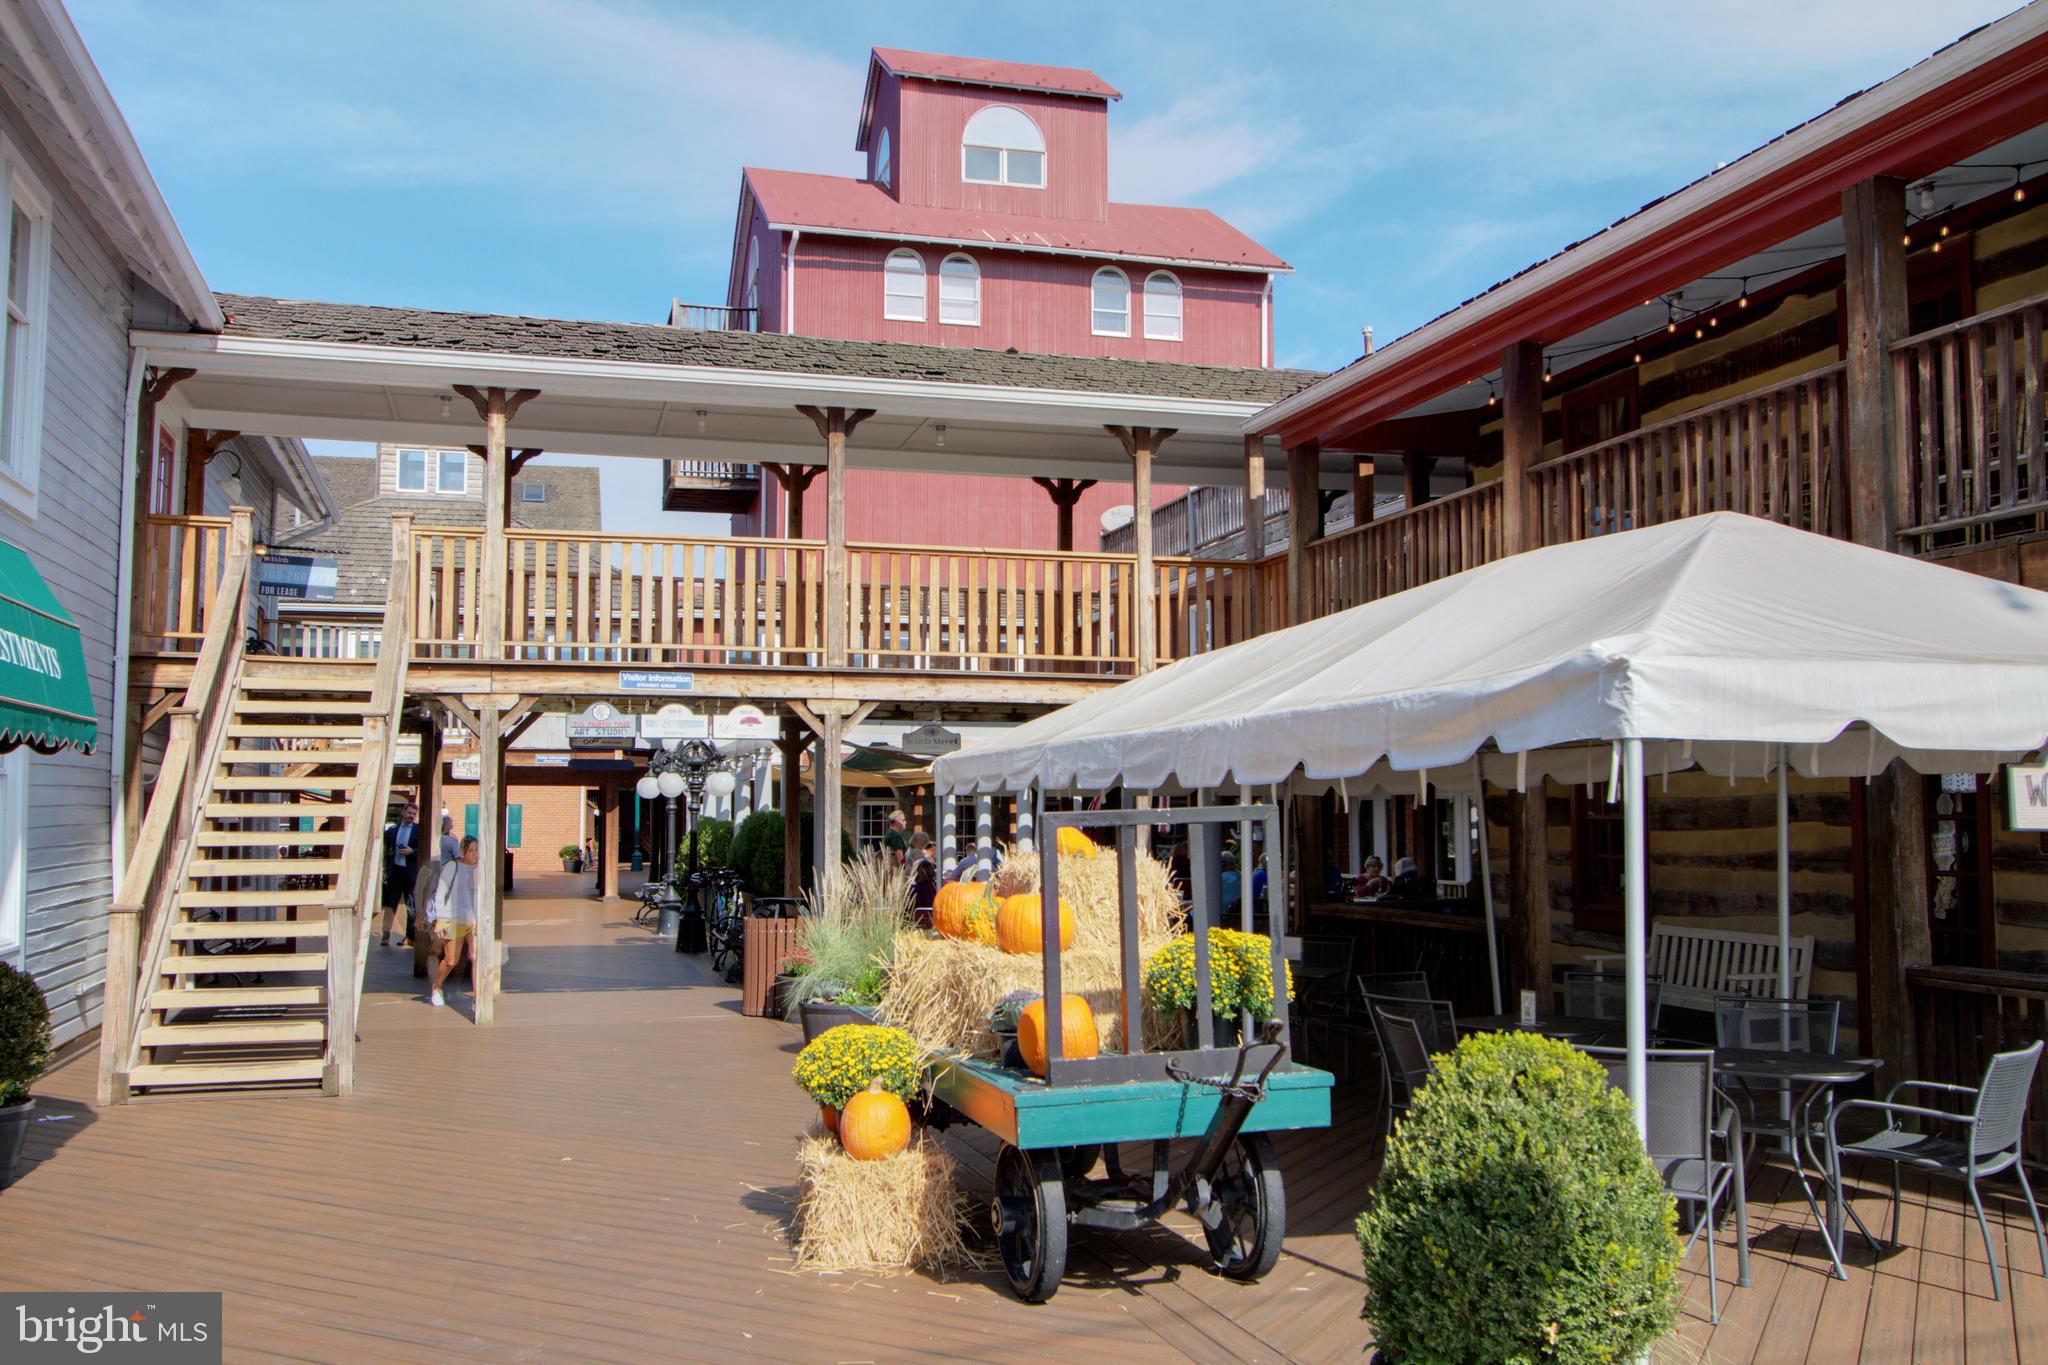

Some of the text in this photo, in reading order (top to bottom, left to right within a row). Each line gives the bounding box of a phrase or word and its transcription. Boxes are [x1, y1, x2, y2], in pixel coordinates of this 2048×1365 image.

[261, 586, 298, 596] FOR LEASE
[622, 673, 692, 683] Visitor Information
[574, 728, 589, 736] ART
